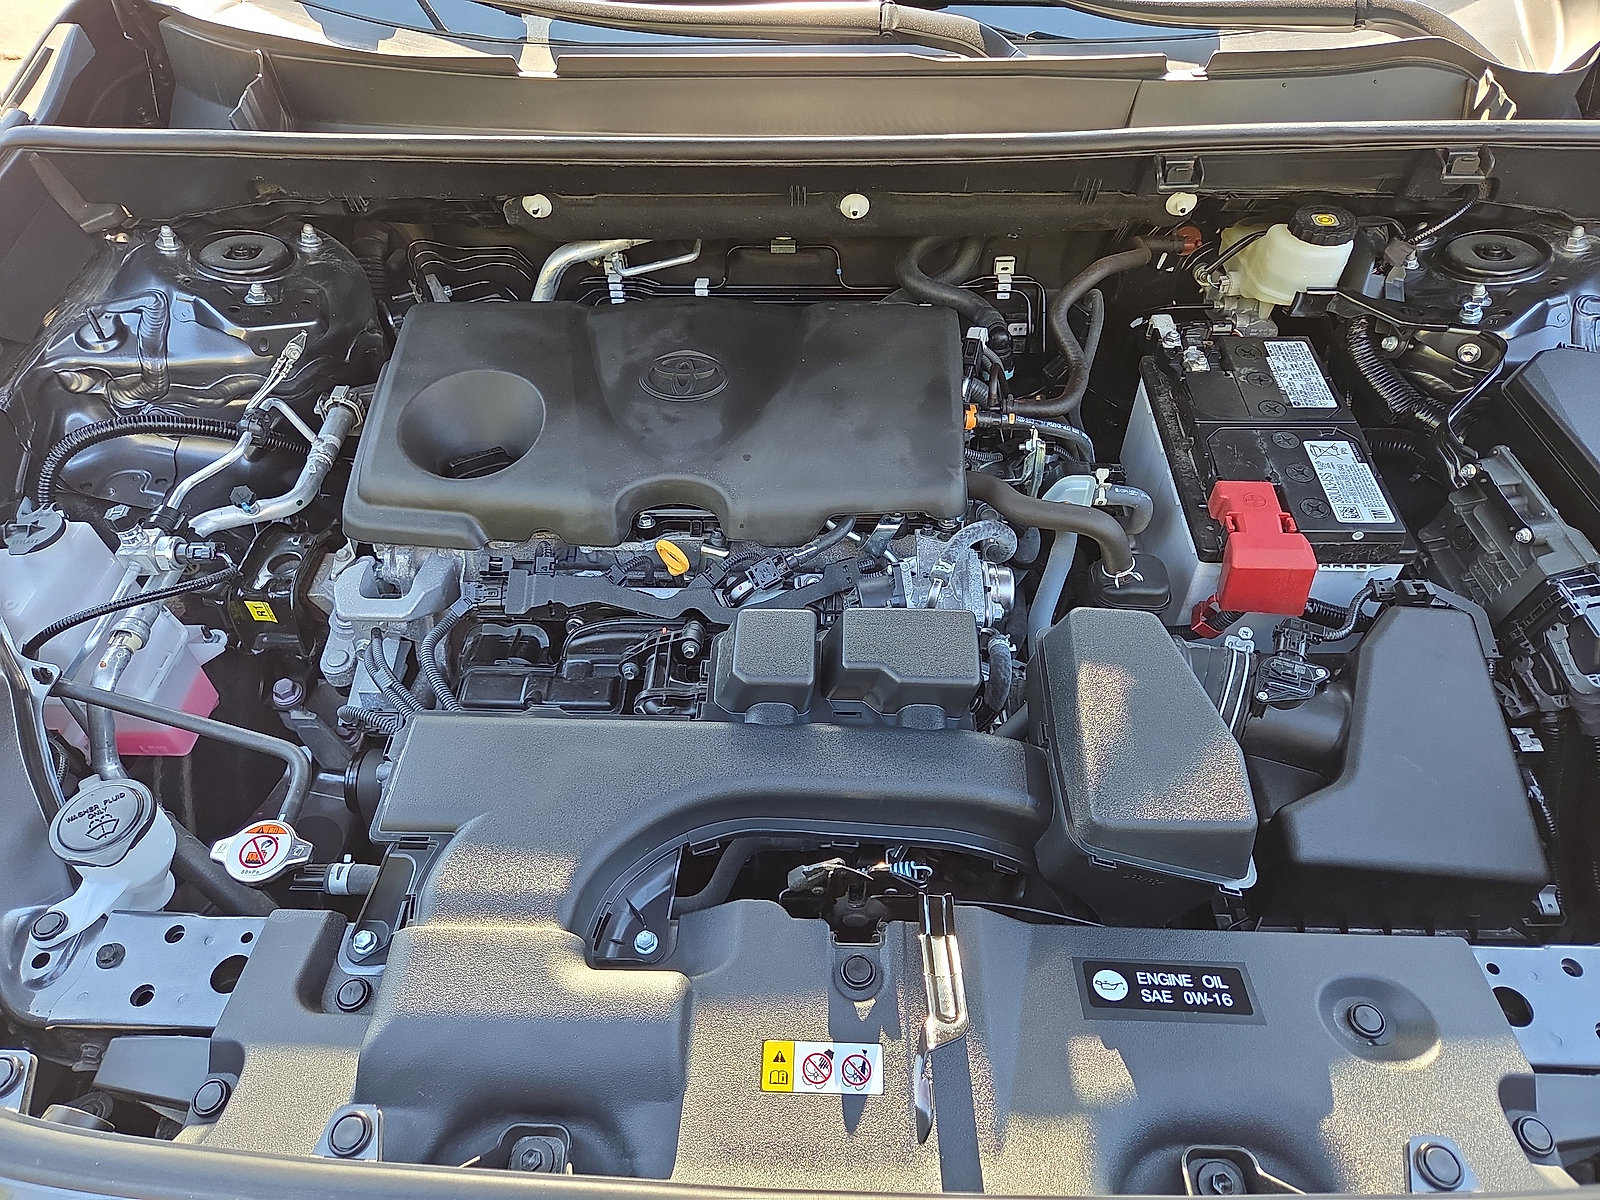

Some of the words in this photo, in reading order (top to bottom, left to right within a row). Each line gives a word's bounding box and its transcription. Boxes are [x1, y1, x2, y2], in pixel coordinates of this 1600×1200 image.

[65, 804, 100, 824] WASHER
[103, 792, 126, 806] FLUID
[87, 806, 108, 820] ONLY
[1136, 972, 1193, 987] ENGINE
[1202, 975, 1229, 989] OIL
[1140, 989, 1174, 1004] SAE
[1183, 992, 1233, 1006] 0W-16
